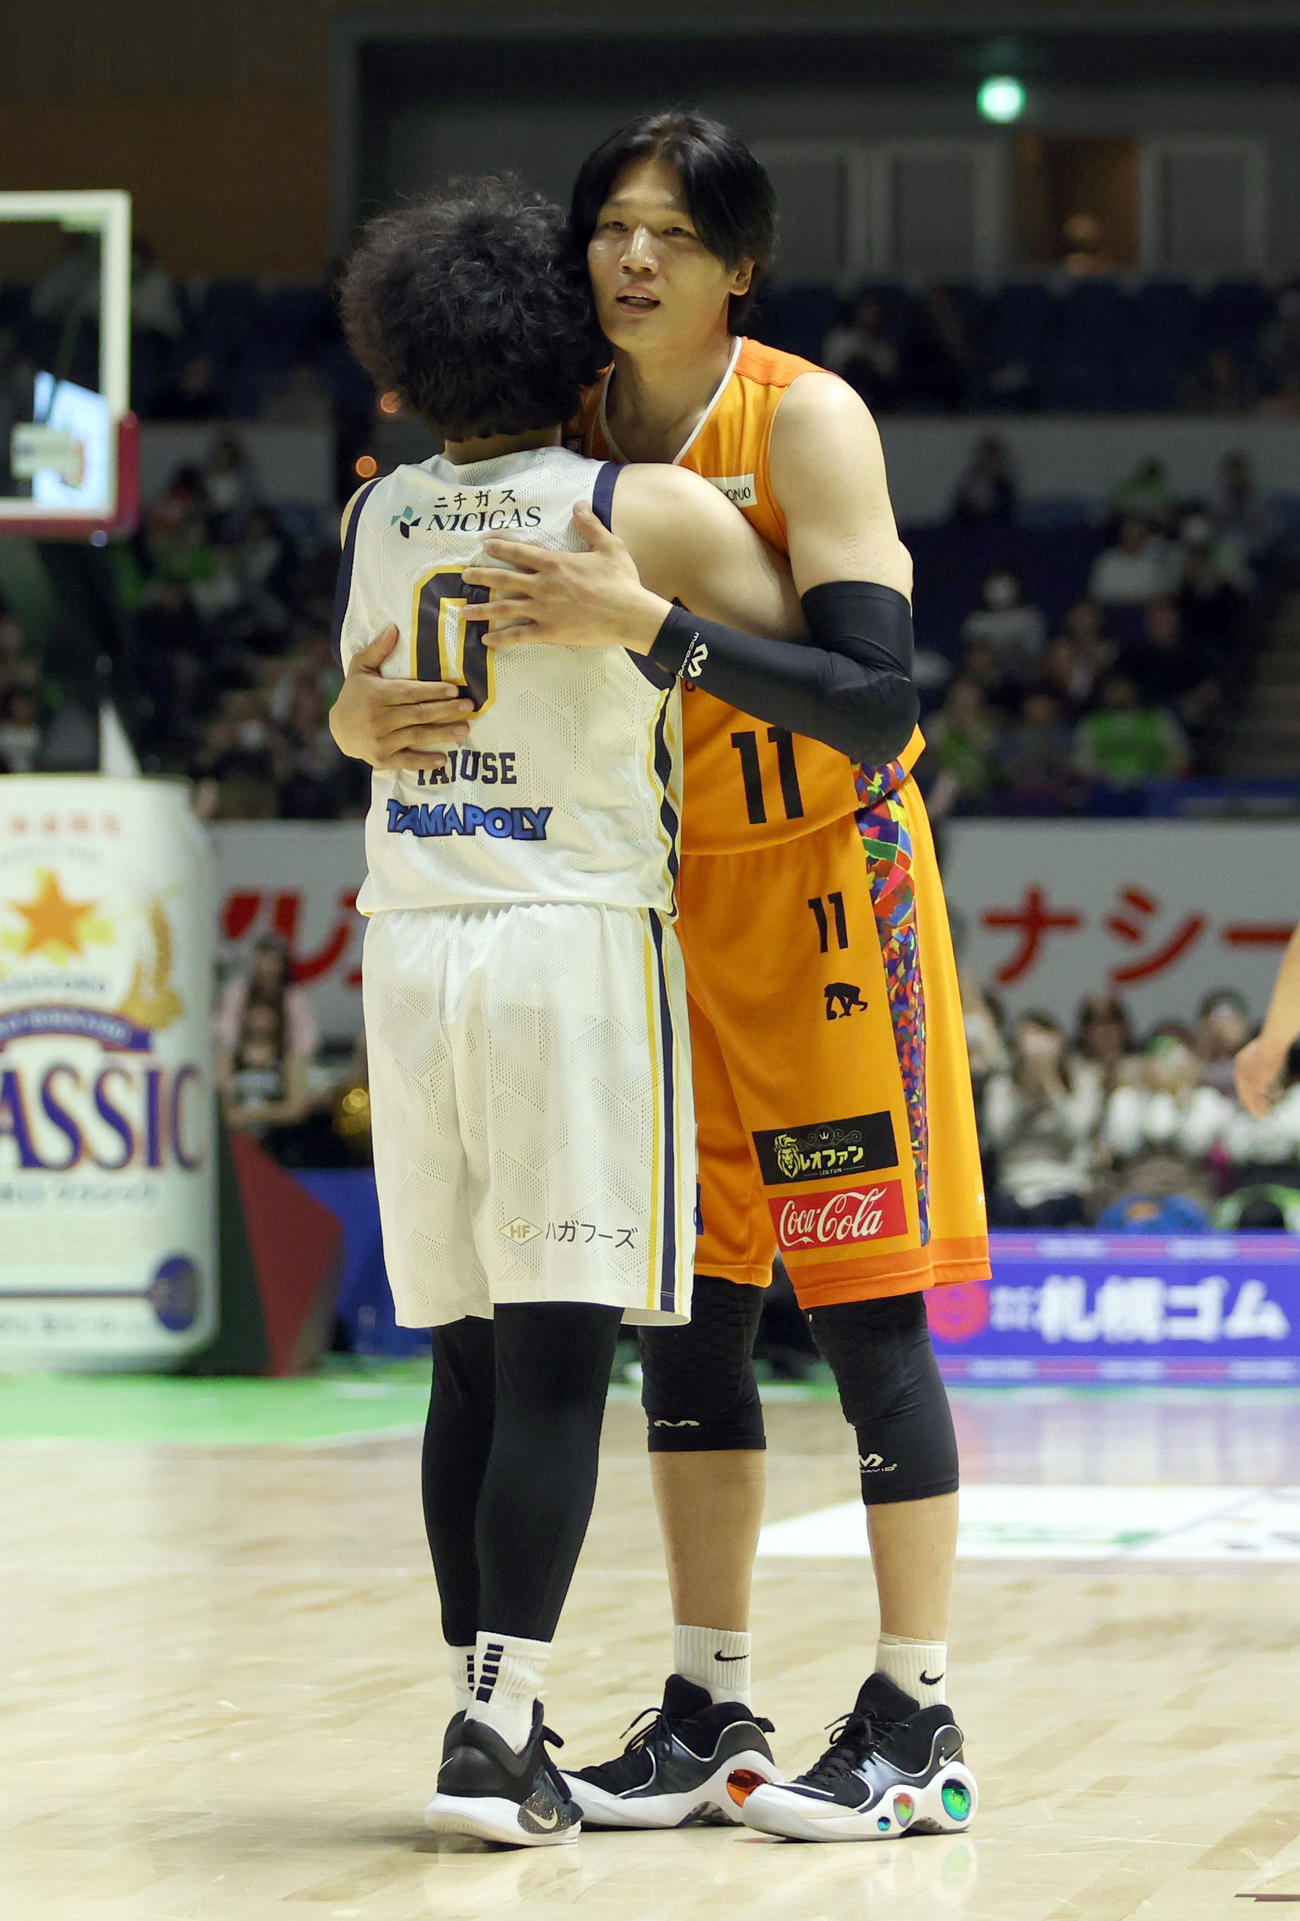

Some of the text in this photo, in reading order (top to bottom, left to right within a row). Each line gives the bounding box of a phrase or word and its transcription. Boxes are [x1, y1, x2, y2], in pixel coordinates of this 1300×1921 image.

[434, 489, 516, 510] ニチガス
[427, 506, 541, 531] NICIGAS
[730, 726, 804, 824] 11
[386, 798, 553, 840] TAMAPOLY
[808, 891, 848, 953] 11
[800, 1146, 864, 1170] レオファン
[510, 1219, 639, 1249] HF ハガフーズ
[779, 1187, 887, 1247] Coca-Cola
